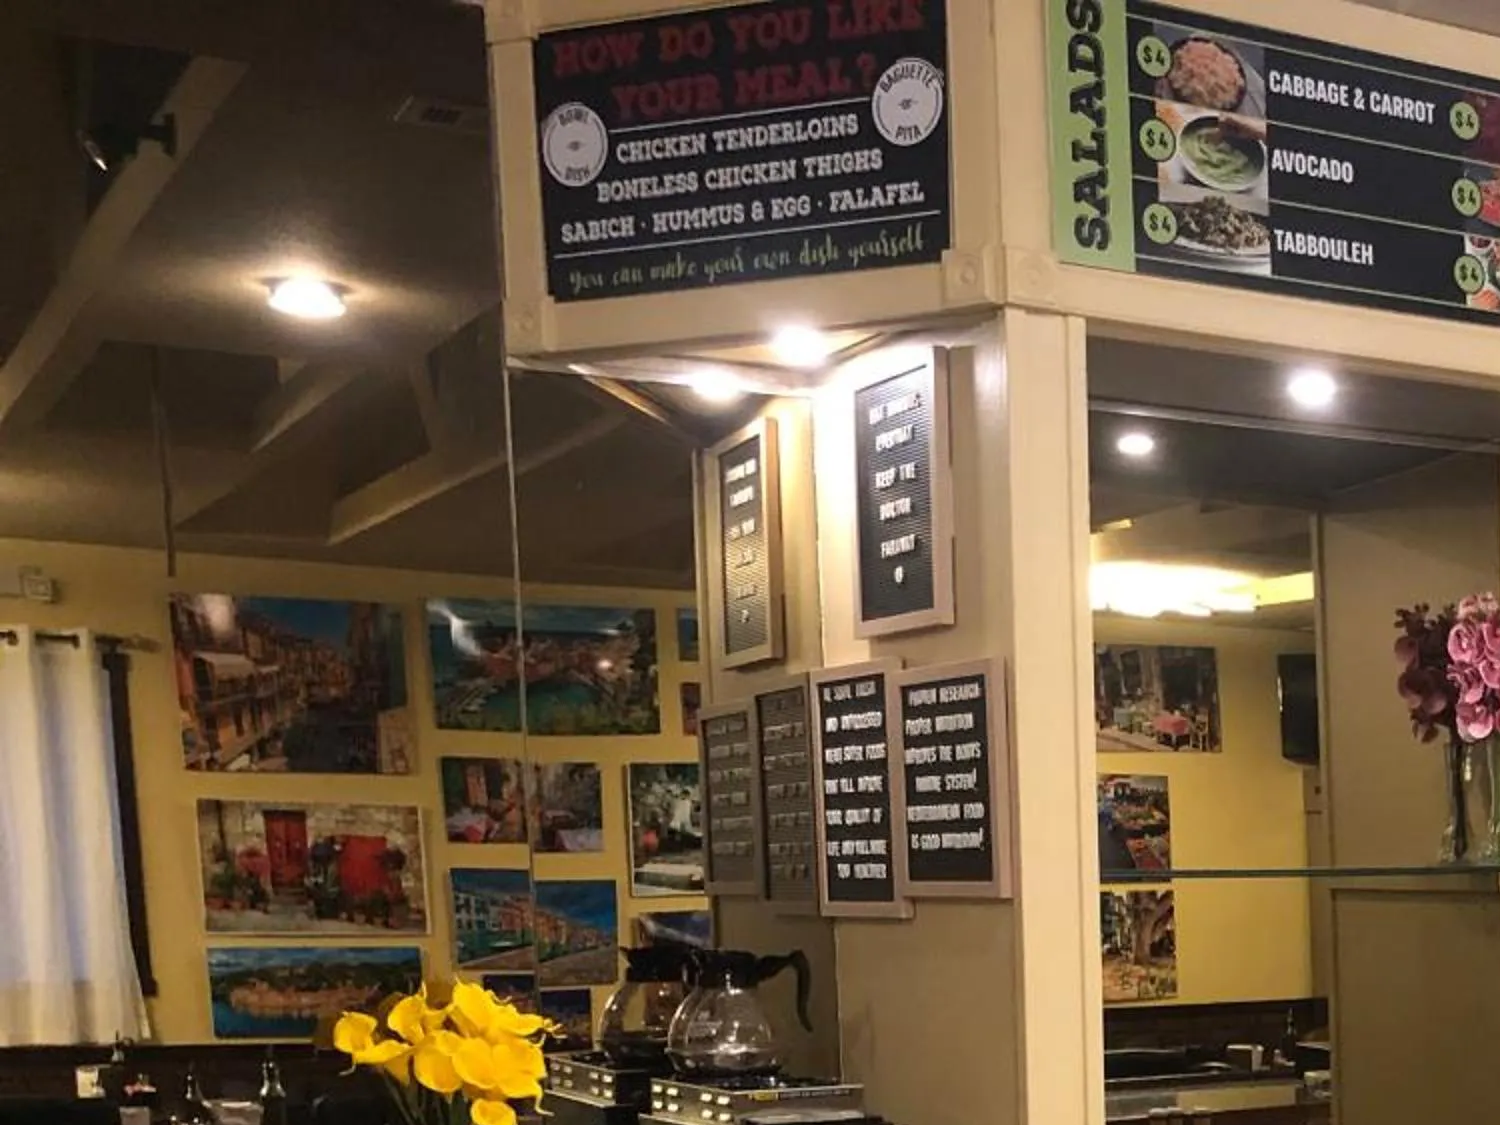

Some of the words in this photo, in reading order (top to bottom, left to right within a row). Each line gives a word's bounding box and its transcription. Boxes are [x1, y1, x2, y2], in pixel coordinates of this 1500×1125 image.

[554, 34, 642, 77] HOW
[659, 25, 715, 62] DO
[726, 7, 812, 54] YOU
[828, 0, 924, 44] LIKE
[612, 74, 724, 119] YOUR
[1268, 70, 1350, 107] CABBAGE
[1353, 86, 1364, 109] &
[1370, 91, 1436, 125] CARROT
[616, 133, 706, 164] CHICKEN
[712, 113, 859, 152] TENDERLOINS
[895, 125, 921, 140] PITA
[1066, 0, 1112, 251] SALADS
[596, 172, 699, 203] BONELESS
[705, 159, 798, 191] CHICKEN
[803, 149, 883, 178] THIGHS
[1272, 149, 1354, 184] AVOCADO
[561, 215, 635, 244] SABICH
[653, 205, 744, 234] HUMMUS
[750, 201, 764, 222] &
[771, 196, 811, 219] EGG
[829, 181, 924, 213] FALAFEL
[1274, 229, 1374, 266] TABBOULEH
